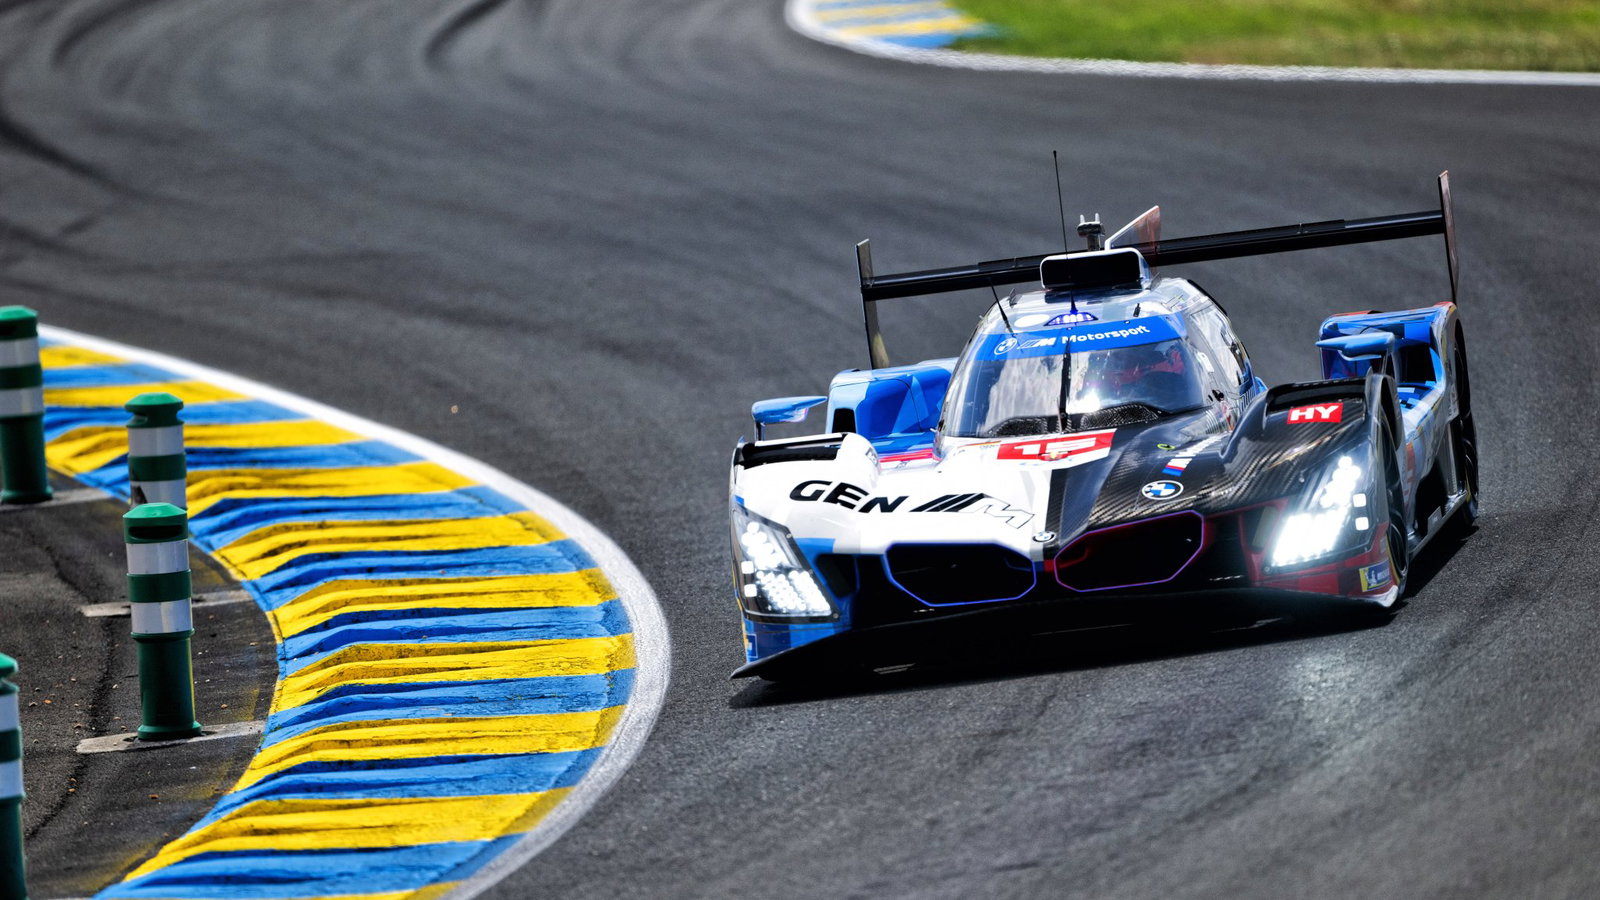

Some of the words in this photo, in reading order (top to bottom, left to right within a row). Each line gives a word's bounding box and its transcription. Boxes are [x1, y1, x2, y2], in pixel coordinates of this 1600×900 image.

[1061, 325, 1151, 345] Motorsport
[1290, 405, 1340, 422] HY
[789, 479, 911, 514] GEN
